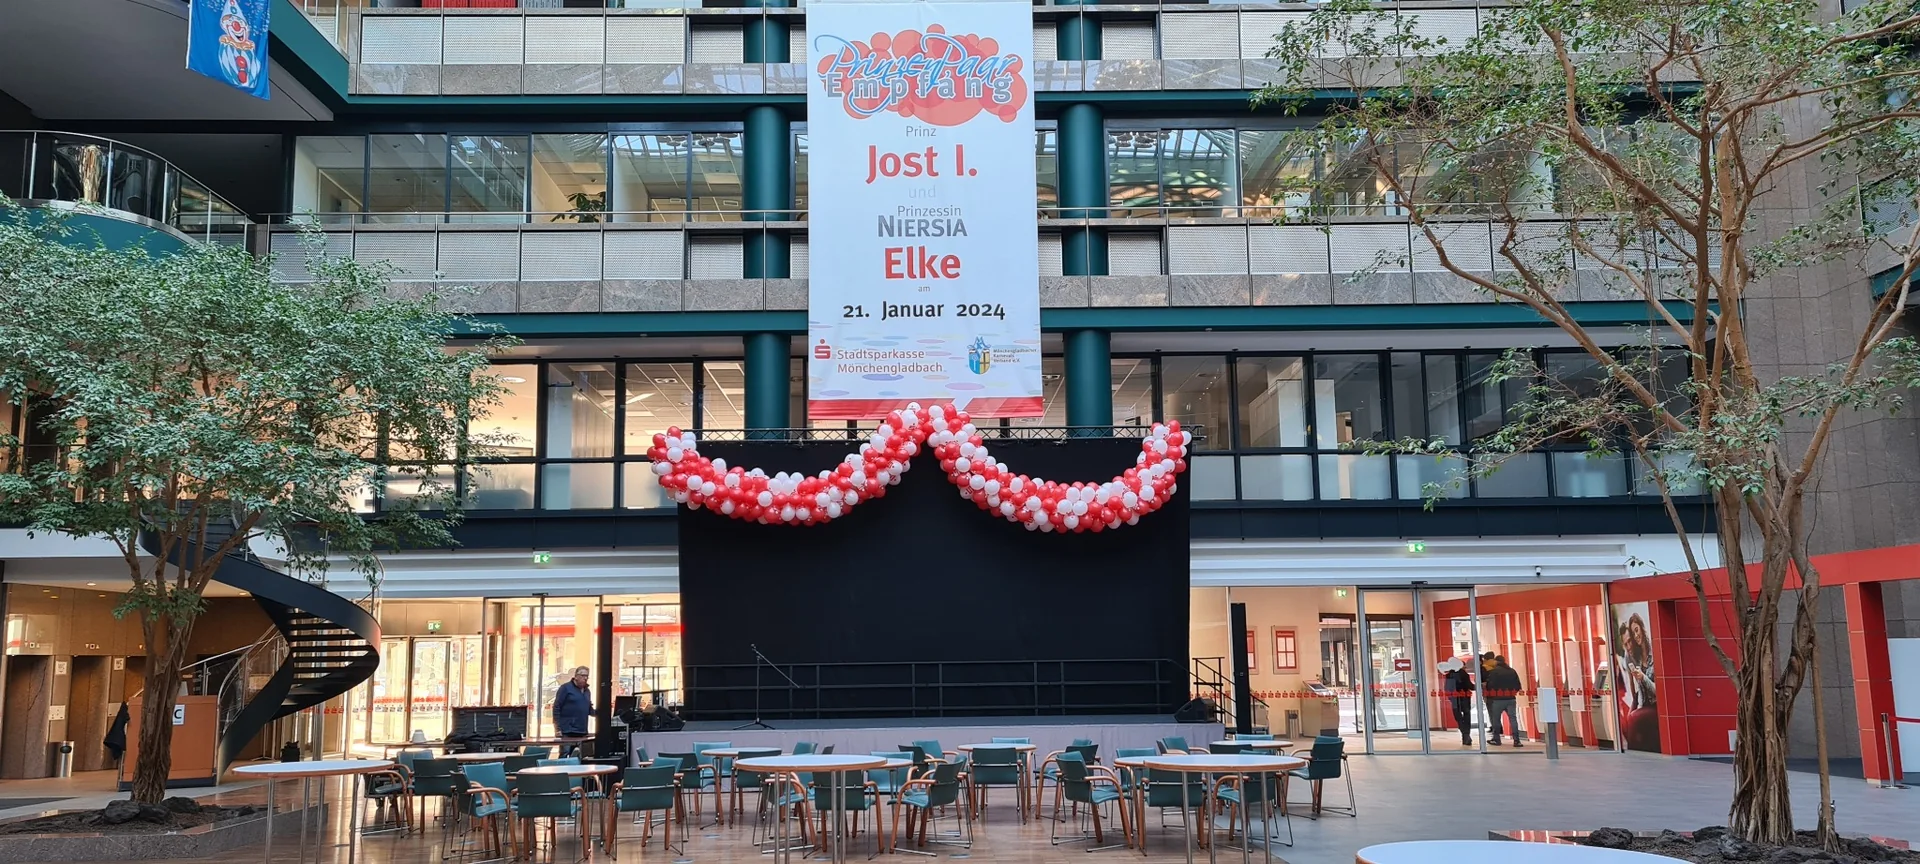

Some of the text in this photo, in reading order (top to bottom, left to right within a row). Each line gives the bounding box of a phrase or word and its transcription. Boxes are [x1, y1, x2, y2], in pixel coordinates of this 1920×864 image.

[814, 34, 1018, 114] PrinzenPaar
[827, 71, 1012, 104] Empfang
[906, 126, 937, 137] Prinz
[865, 144, 978, 184] Jost I.
[909, 185, 937, 198] und
[897, 205, 962, 217] Prinzessin
[878, 215, 968, 237] NIERSIA
[884, 246, 961, 279] Elke
[843, 301, 1006, 320] 21. Januar 2024
[837, 349, 925, 361] Stadtsparkasse
[837, 362, 943, 376] Mönchengladbach
[174, 709, 182, 719] C
